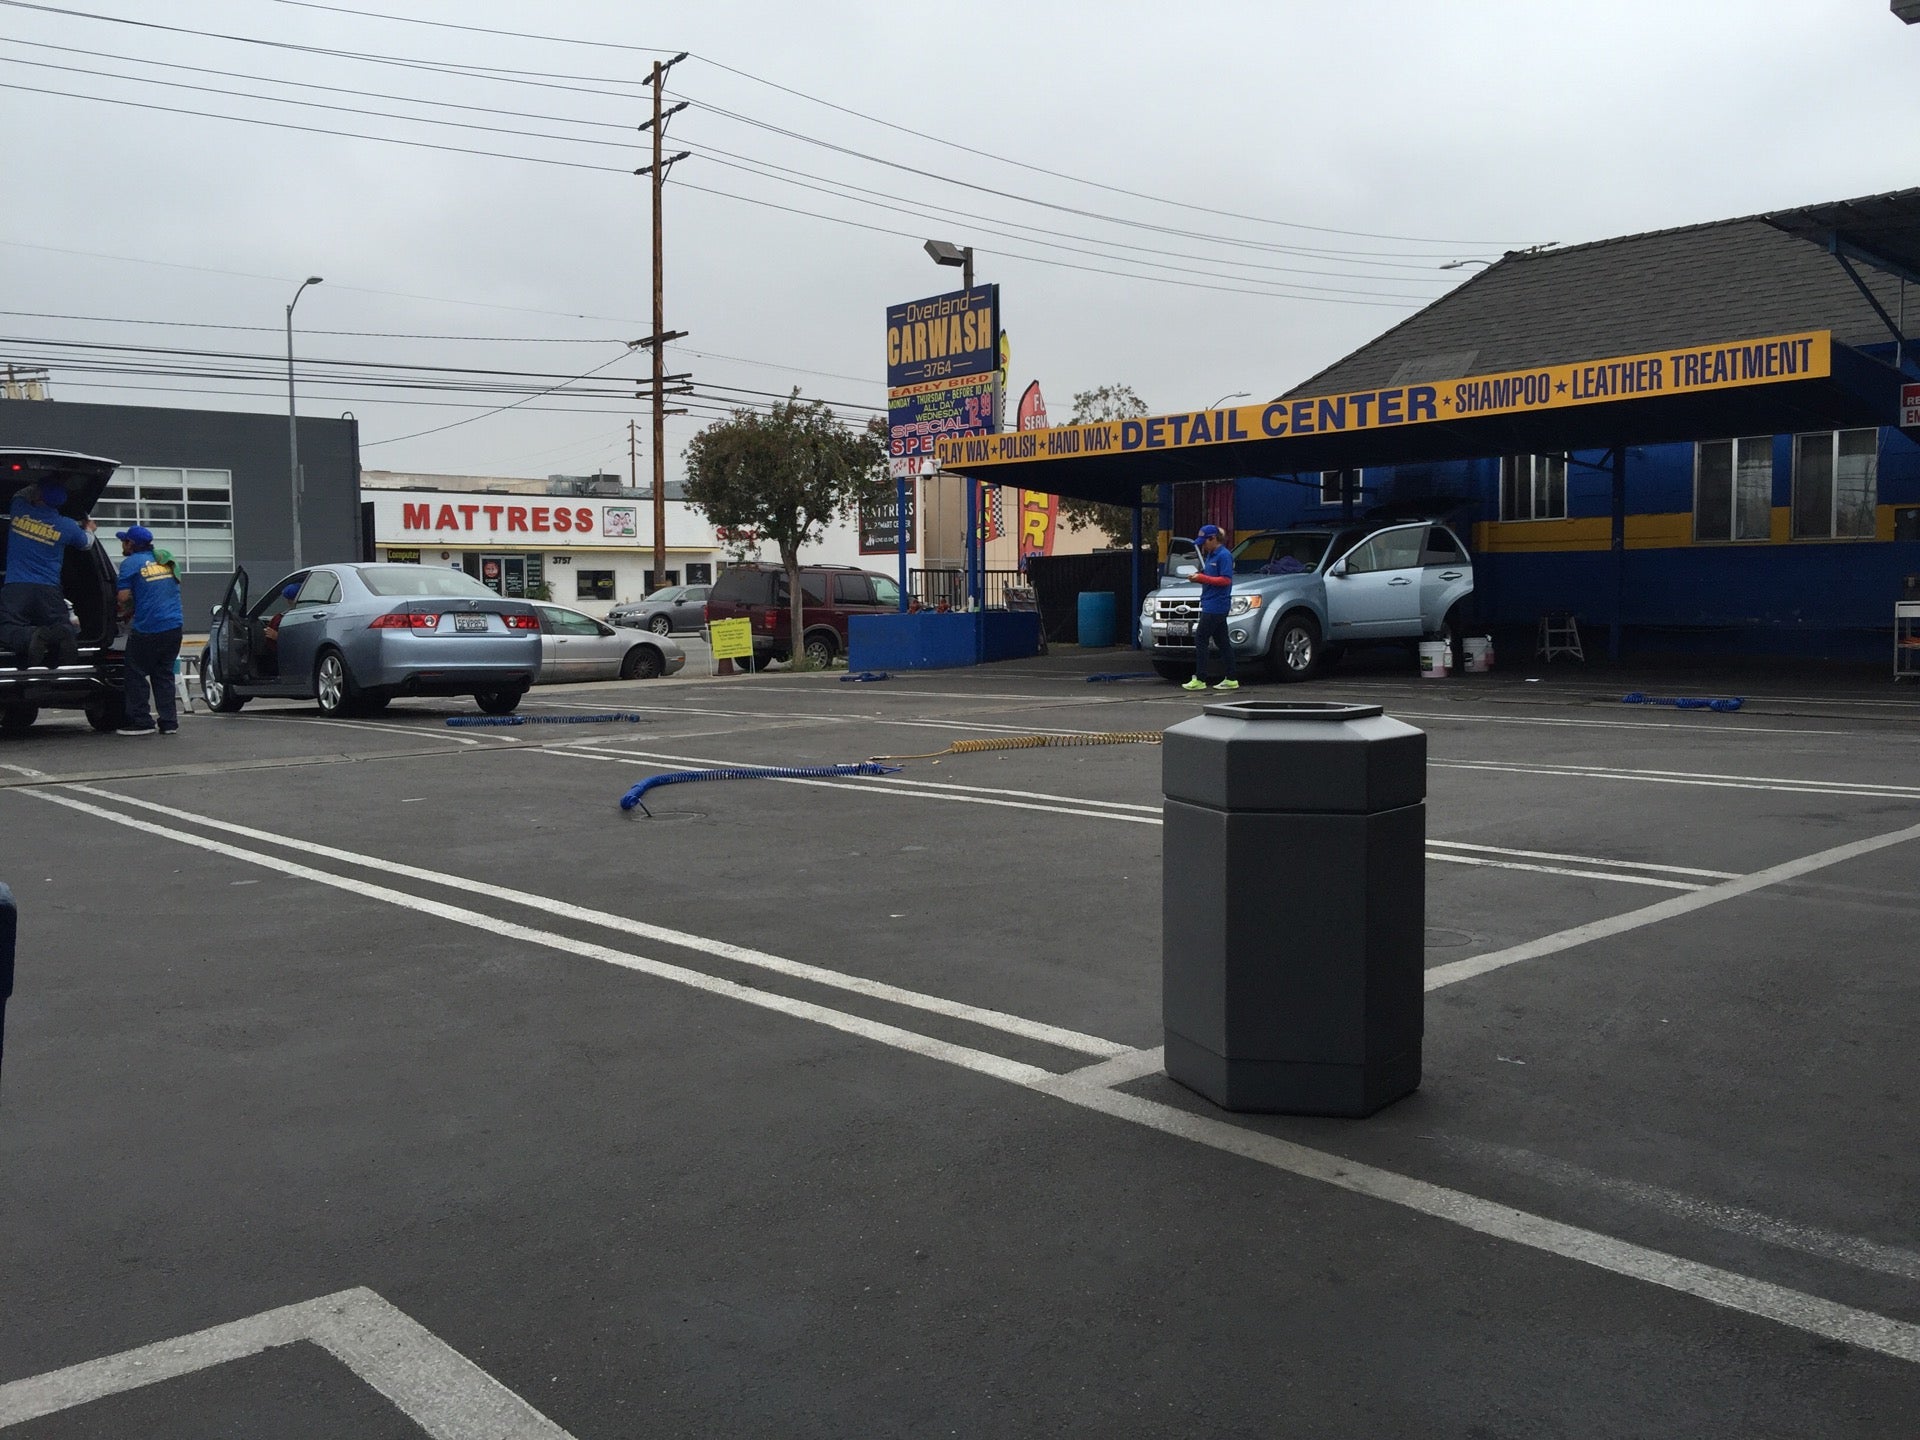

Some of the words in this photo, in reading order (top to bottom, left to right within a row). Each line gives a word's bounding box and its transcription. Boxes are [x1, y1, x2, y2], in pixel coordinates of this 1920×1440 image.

[906, 291, 970, 323] Overland
[887, 307, 992, 367] CARWASH
[923, 360, 952, 378] 3764
[888, 398, 911, 410] MONDAY
[916, 392, 946, 406] THURSDAY
[952, 386, 974, 400] BEFORE
[891, 381, 943, 398] EARLY
[948, 374, 989, 388] BIRD
[923, 403, 938, 412] ALL
[939, 400, 956, 409] DAY
[938, 443, 963, 465] CLAY
[966, 439, 990, 462] WAX
[1001, 434, 1036, 460] POLISH
[1048, 429, 1079, 456] HAND
[1084, 426, 1112, 452] WAX
[1120, 409, 1249, 450] DETAIL
[1261, 386, 1438, 437] CENTER
[1455, 373, 1550, 413] SHAMPOO
[1572, 358, 1662, 400] LEATHER
[1670, 338, 1813, 386] TREATMENT
[915, 407, 964, 421] WEDNESDAY
[891, 416, 969, 438] SPECIAL
[403, 503, 594, 533] MATTRESS
[552, 556, 572, 565] 3757
